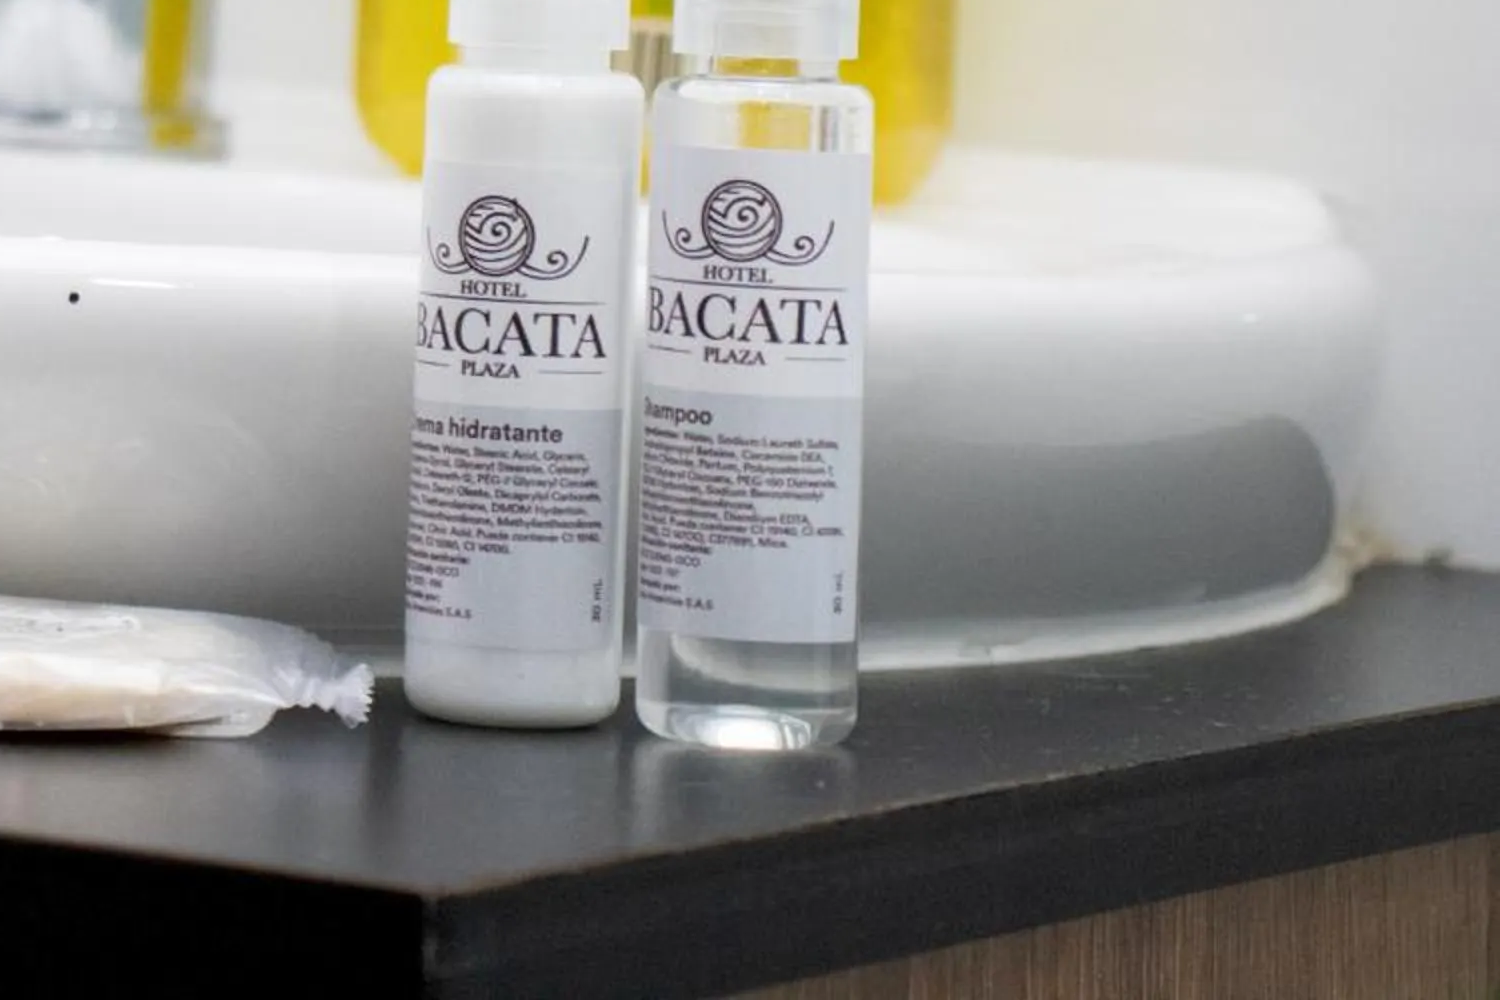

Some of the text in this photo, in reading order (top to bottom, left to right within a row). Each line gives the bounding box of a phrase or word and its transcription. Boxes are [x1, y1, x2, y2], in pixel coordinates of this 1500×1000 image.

[703, 265, 773, 284] HOTEL
[460, 279, 527, 298] HOTEL
[648, 286, 849, 345] BACATA
[417, 301, 607, 359] BACATA
[703, 346, 767, 366] PLAZA
[461, 359, 521, 379] PLAZA
[449, 416, 564, 444] hidratante
